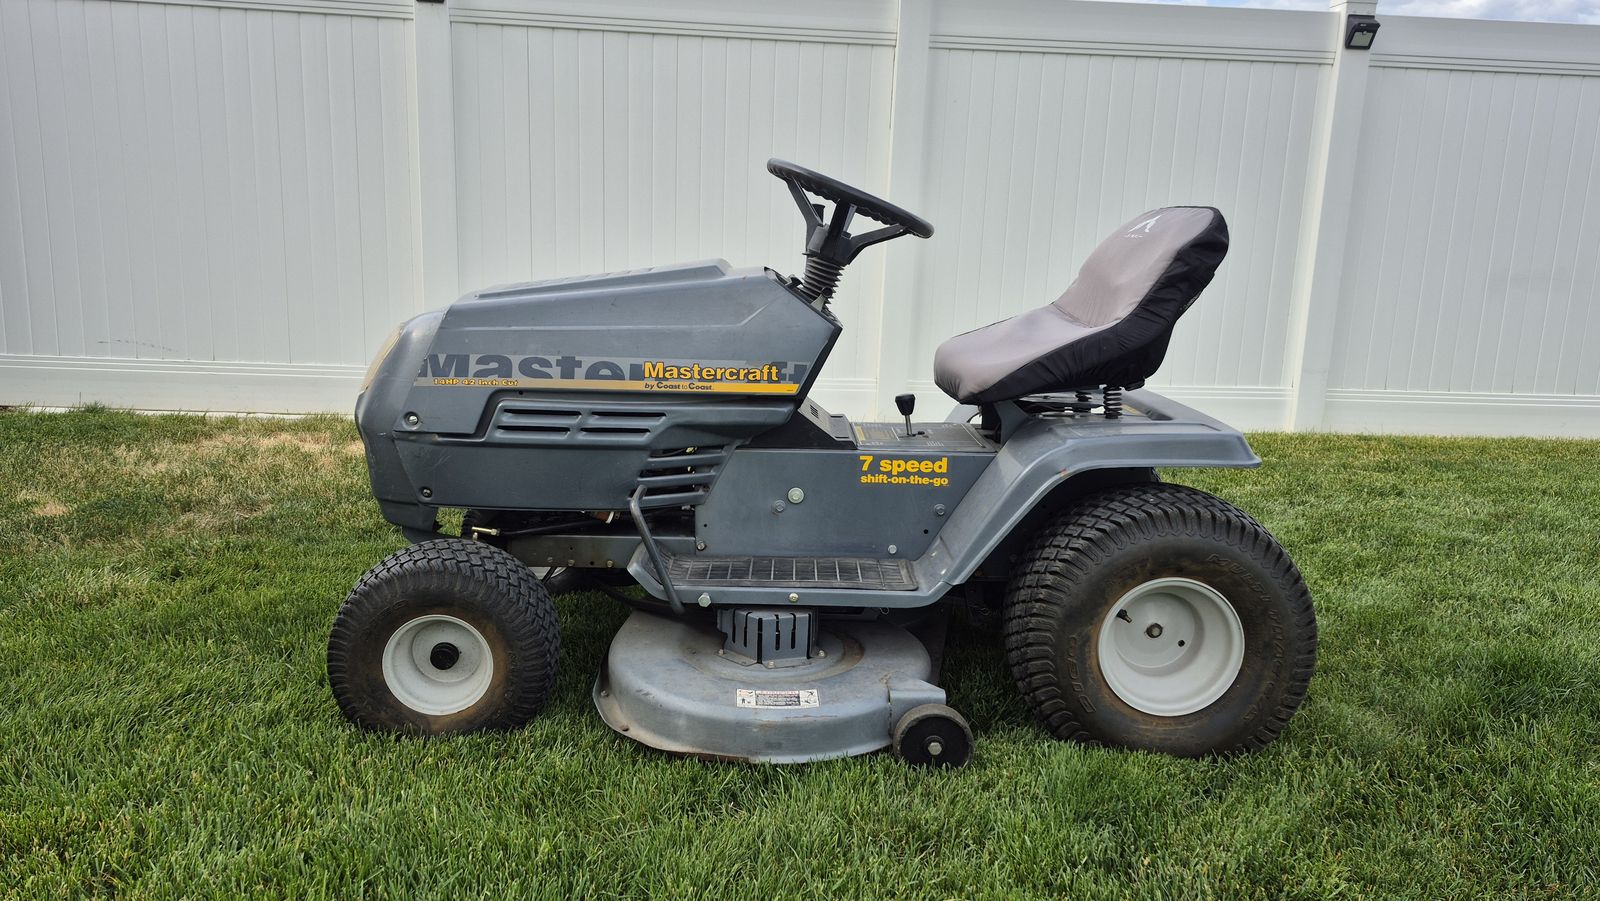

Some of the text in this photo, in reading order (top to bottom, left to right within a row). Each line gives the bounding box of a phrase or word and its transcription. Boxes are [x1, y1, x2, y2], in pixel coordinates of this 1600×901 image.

[643, 360, 779, 381] Mastercraft
[502, 379, 519, 387] Cut
[645, 382, 655, 390] by
[656, 382, 680, 390] Coast
[688, 383, 712, 391] Coast
[859, 455, 948, 475] 7 speed
[860, 474, 949, 487] shift-on-the-go
